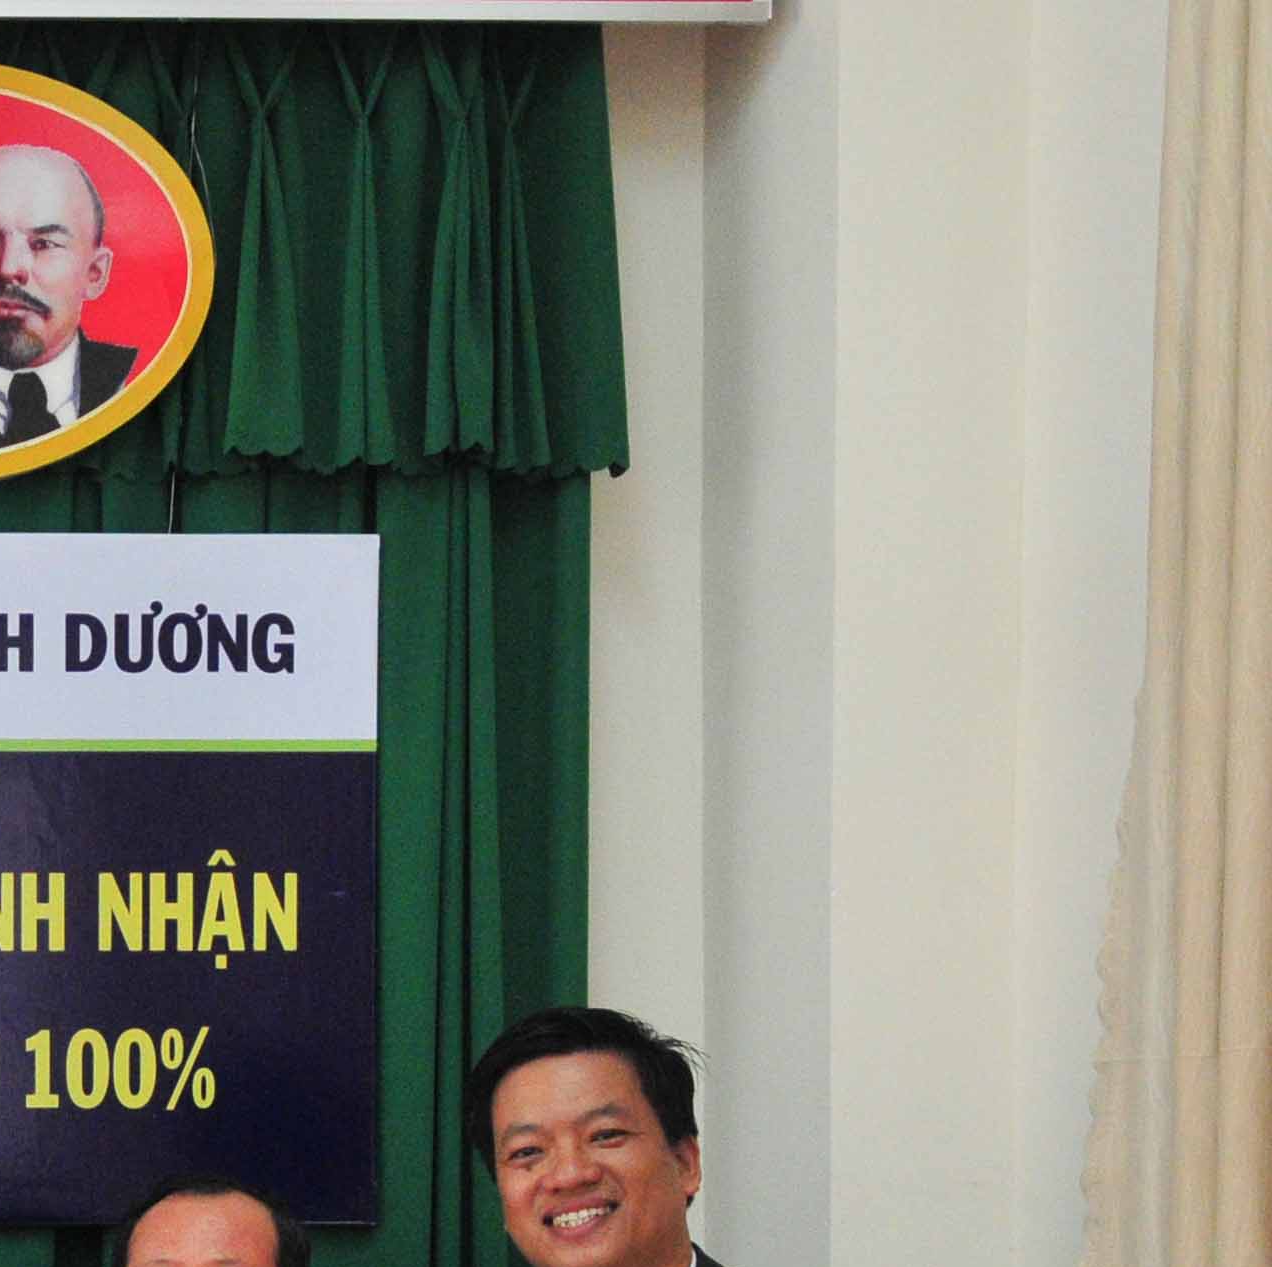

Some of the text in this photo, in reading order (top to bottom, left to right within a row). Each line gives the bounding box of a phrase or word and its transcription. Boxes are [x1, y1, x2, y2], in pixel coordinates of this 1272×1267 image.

[66, 601, 294, 673] DƯƠNG
[99, 850, 297, 969] NHẬN
[26, 1027, 215, 1110] 100%
